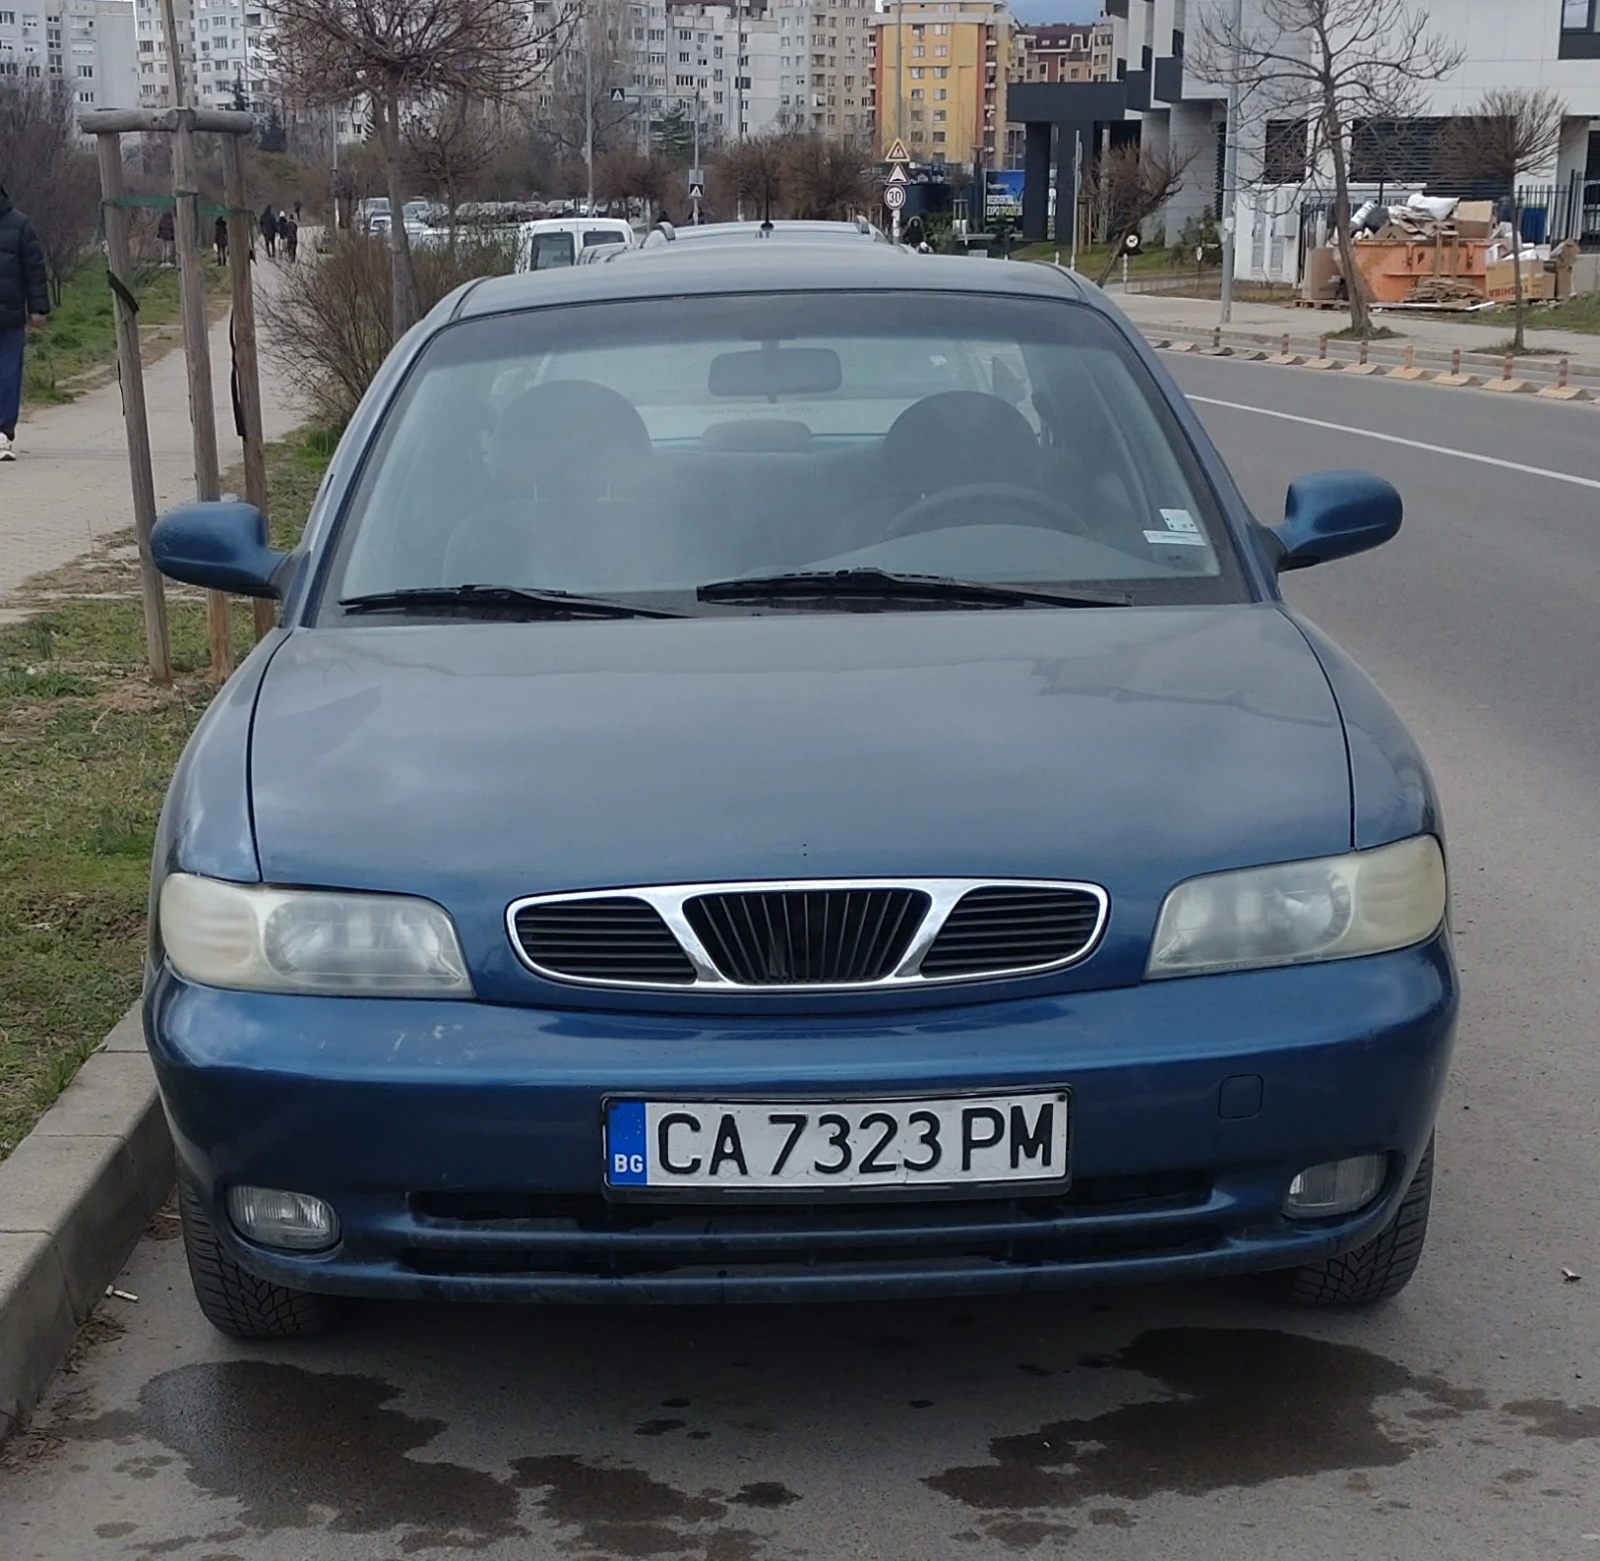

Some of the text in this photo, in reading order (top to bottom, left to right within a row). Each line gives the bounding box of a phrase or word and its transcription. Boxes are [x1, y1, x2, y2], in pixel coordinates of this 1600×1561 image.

[888, 191, 901, 204] 30
[1489, 285, 1529, 298] TSHIBA
[657, 1102, 1054, 1176] CA 7323 PM
[613, 1154, 644, 1174] BG
